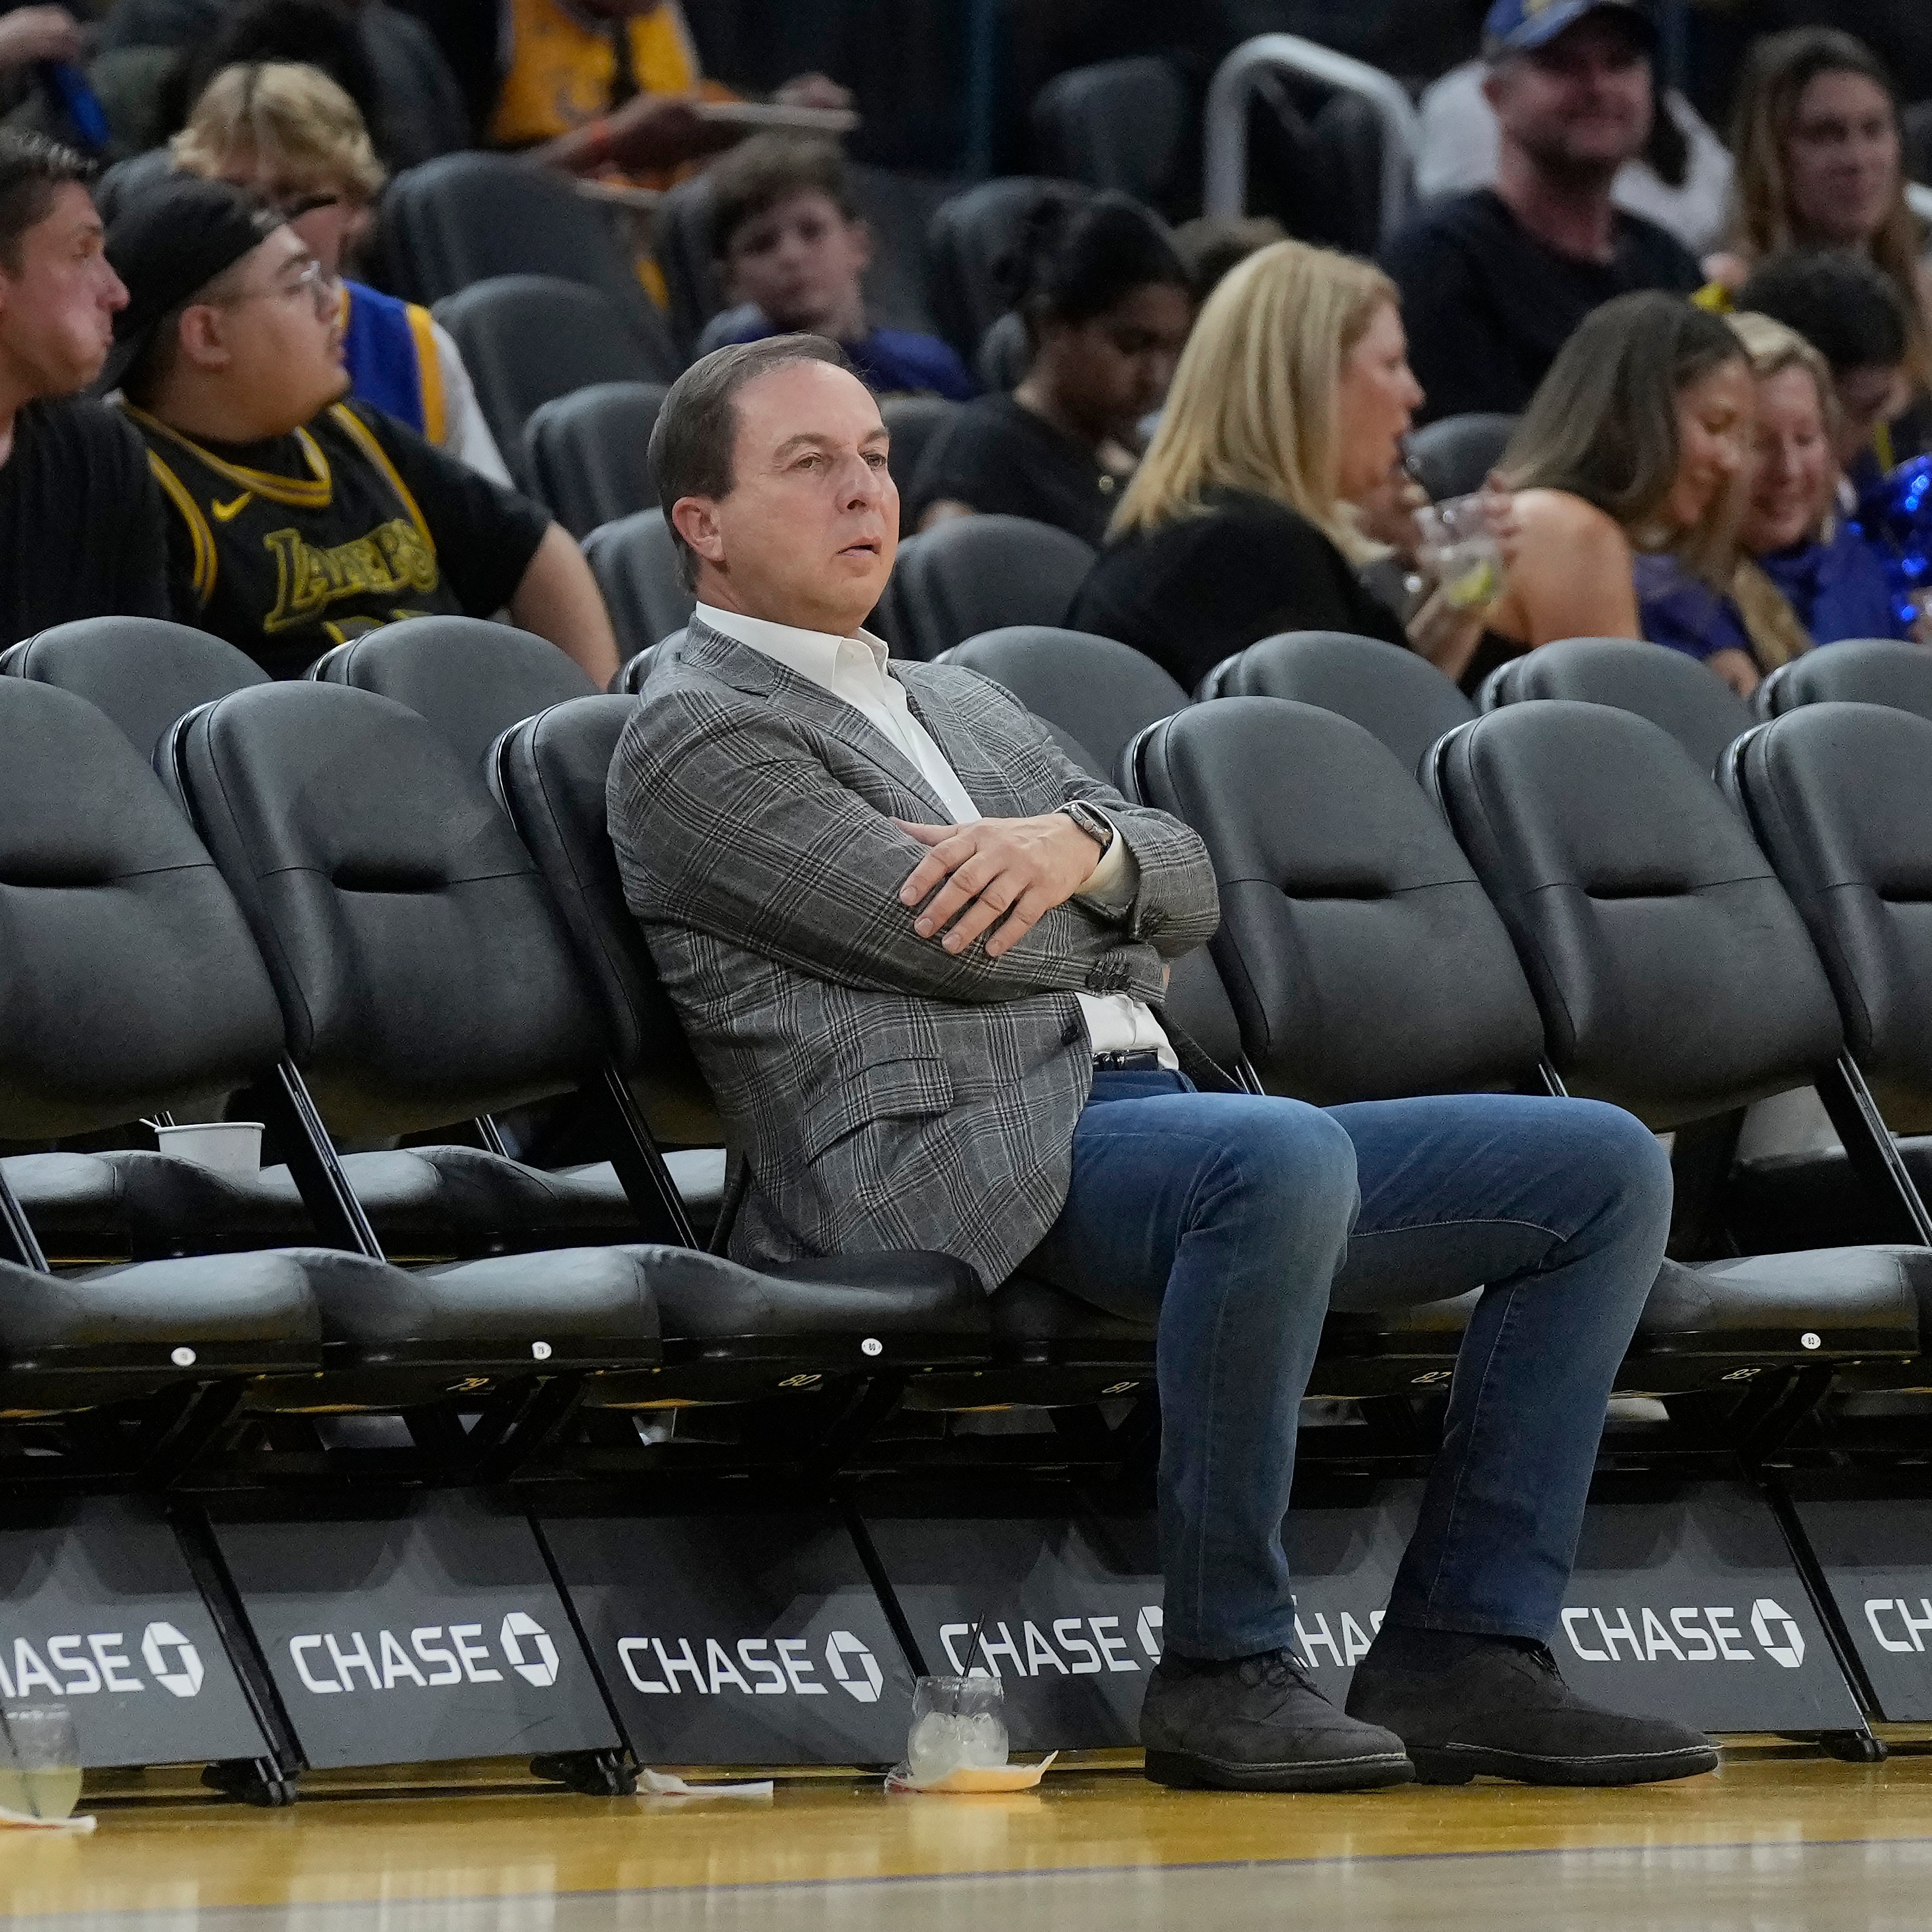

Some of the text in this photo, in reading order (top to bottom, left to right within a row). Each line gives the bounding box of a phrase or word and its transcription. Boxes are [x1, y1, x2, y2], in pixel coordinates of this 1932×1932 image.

[778, 1374, 822, 1387] 80
[1411, 1371, 1453, 1383] 82
[1721, 1368, 1761, 1380] 83
[289, 1624, 503, 1694] CHASE
[939, 1616, 1141, 1679] CHASE
[1559, 1607, 1756, 1661] CHASE
[617, 1638, 829, 1694] CHASE
